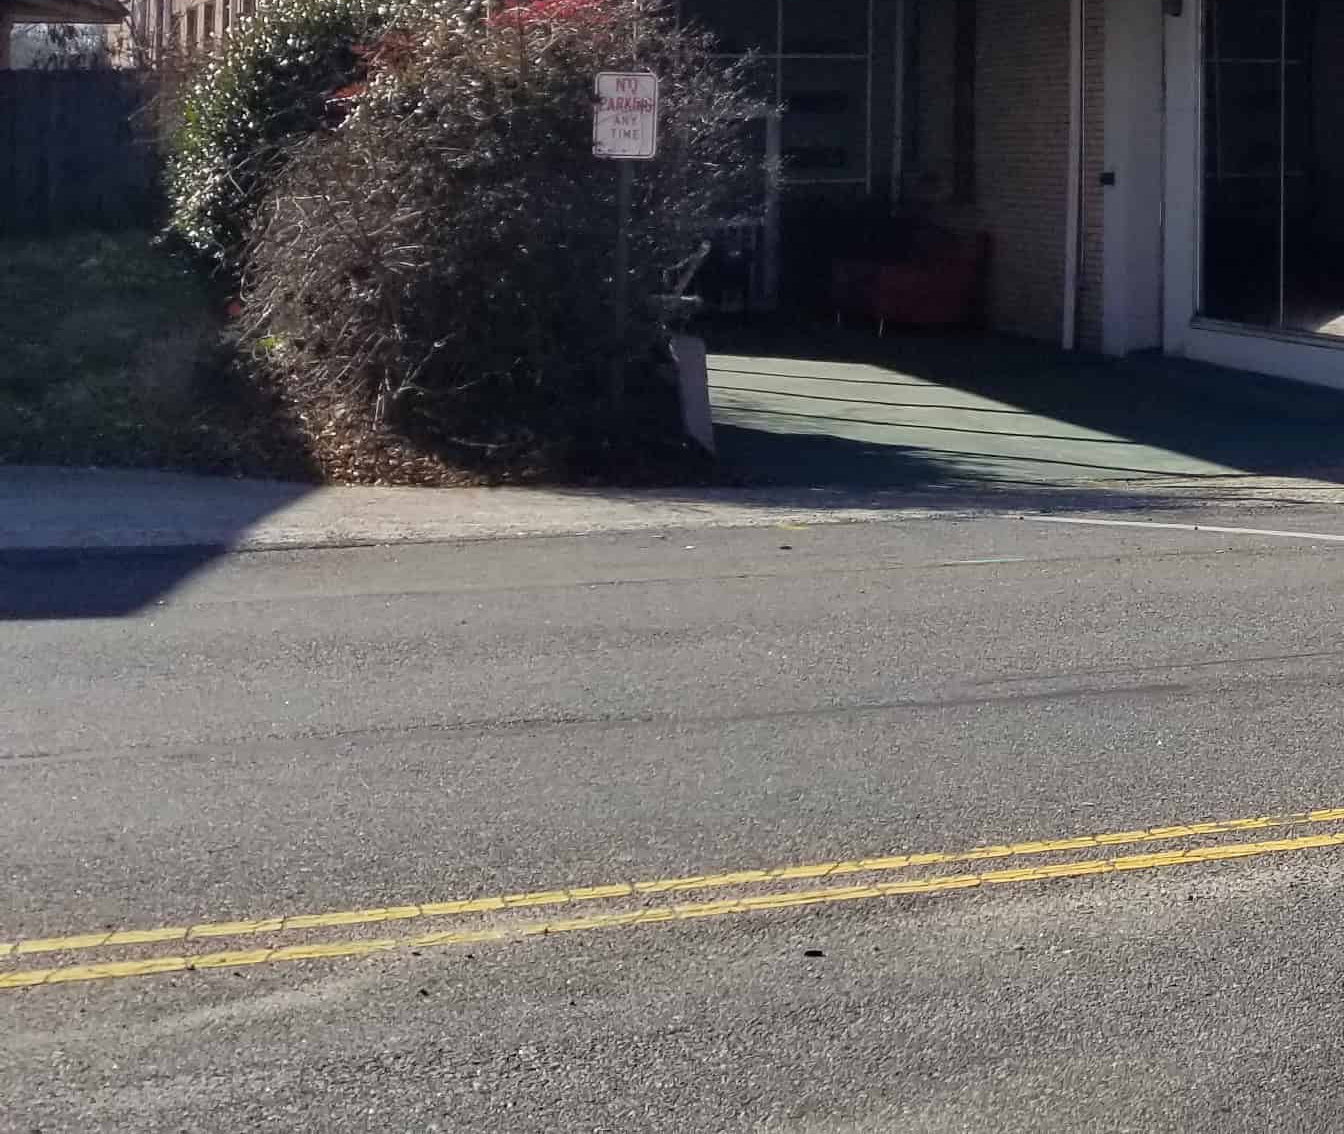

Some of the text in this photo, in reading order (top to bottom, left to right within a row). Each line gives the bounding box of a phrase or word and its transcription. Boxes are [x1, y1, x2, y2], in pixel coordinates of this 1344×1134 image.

[615, 77, 638, 93] NO
[615, 116, 639, 125] ANY
[611, 128, 640, 139] TIME
